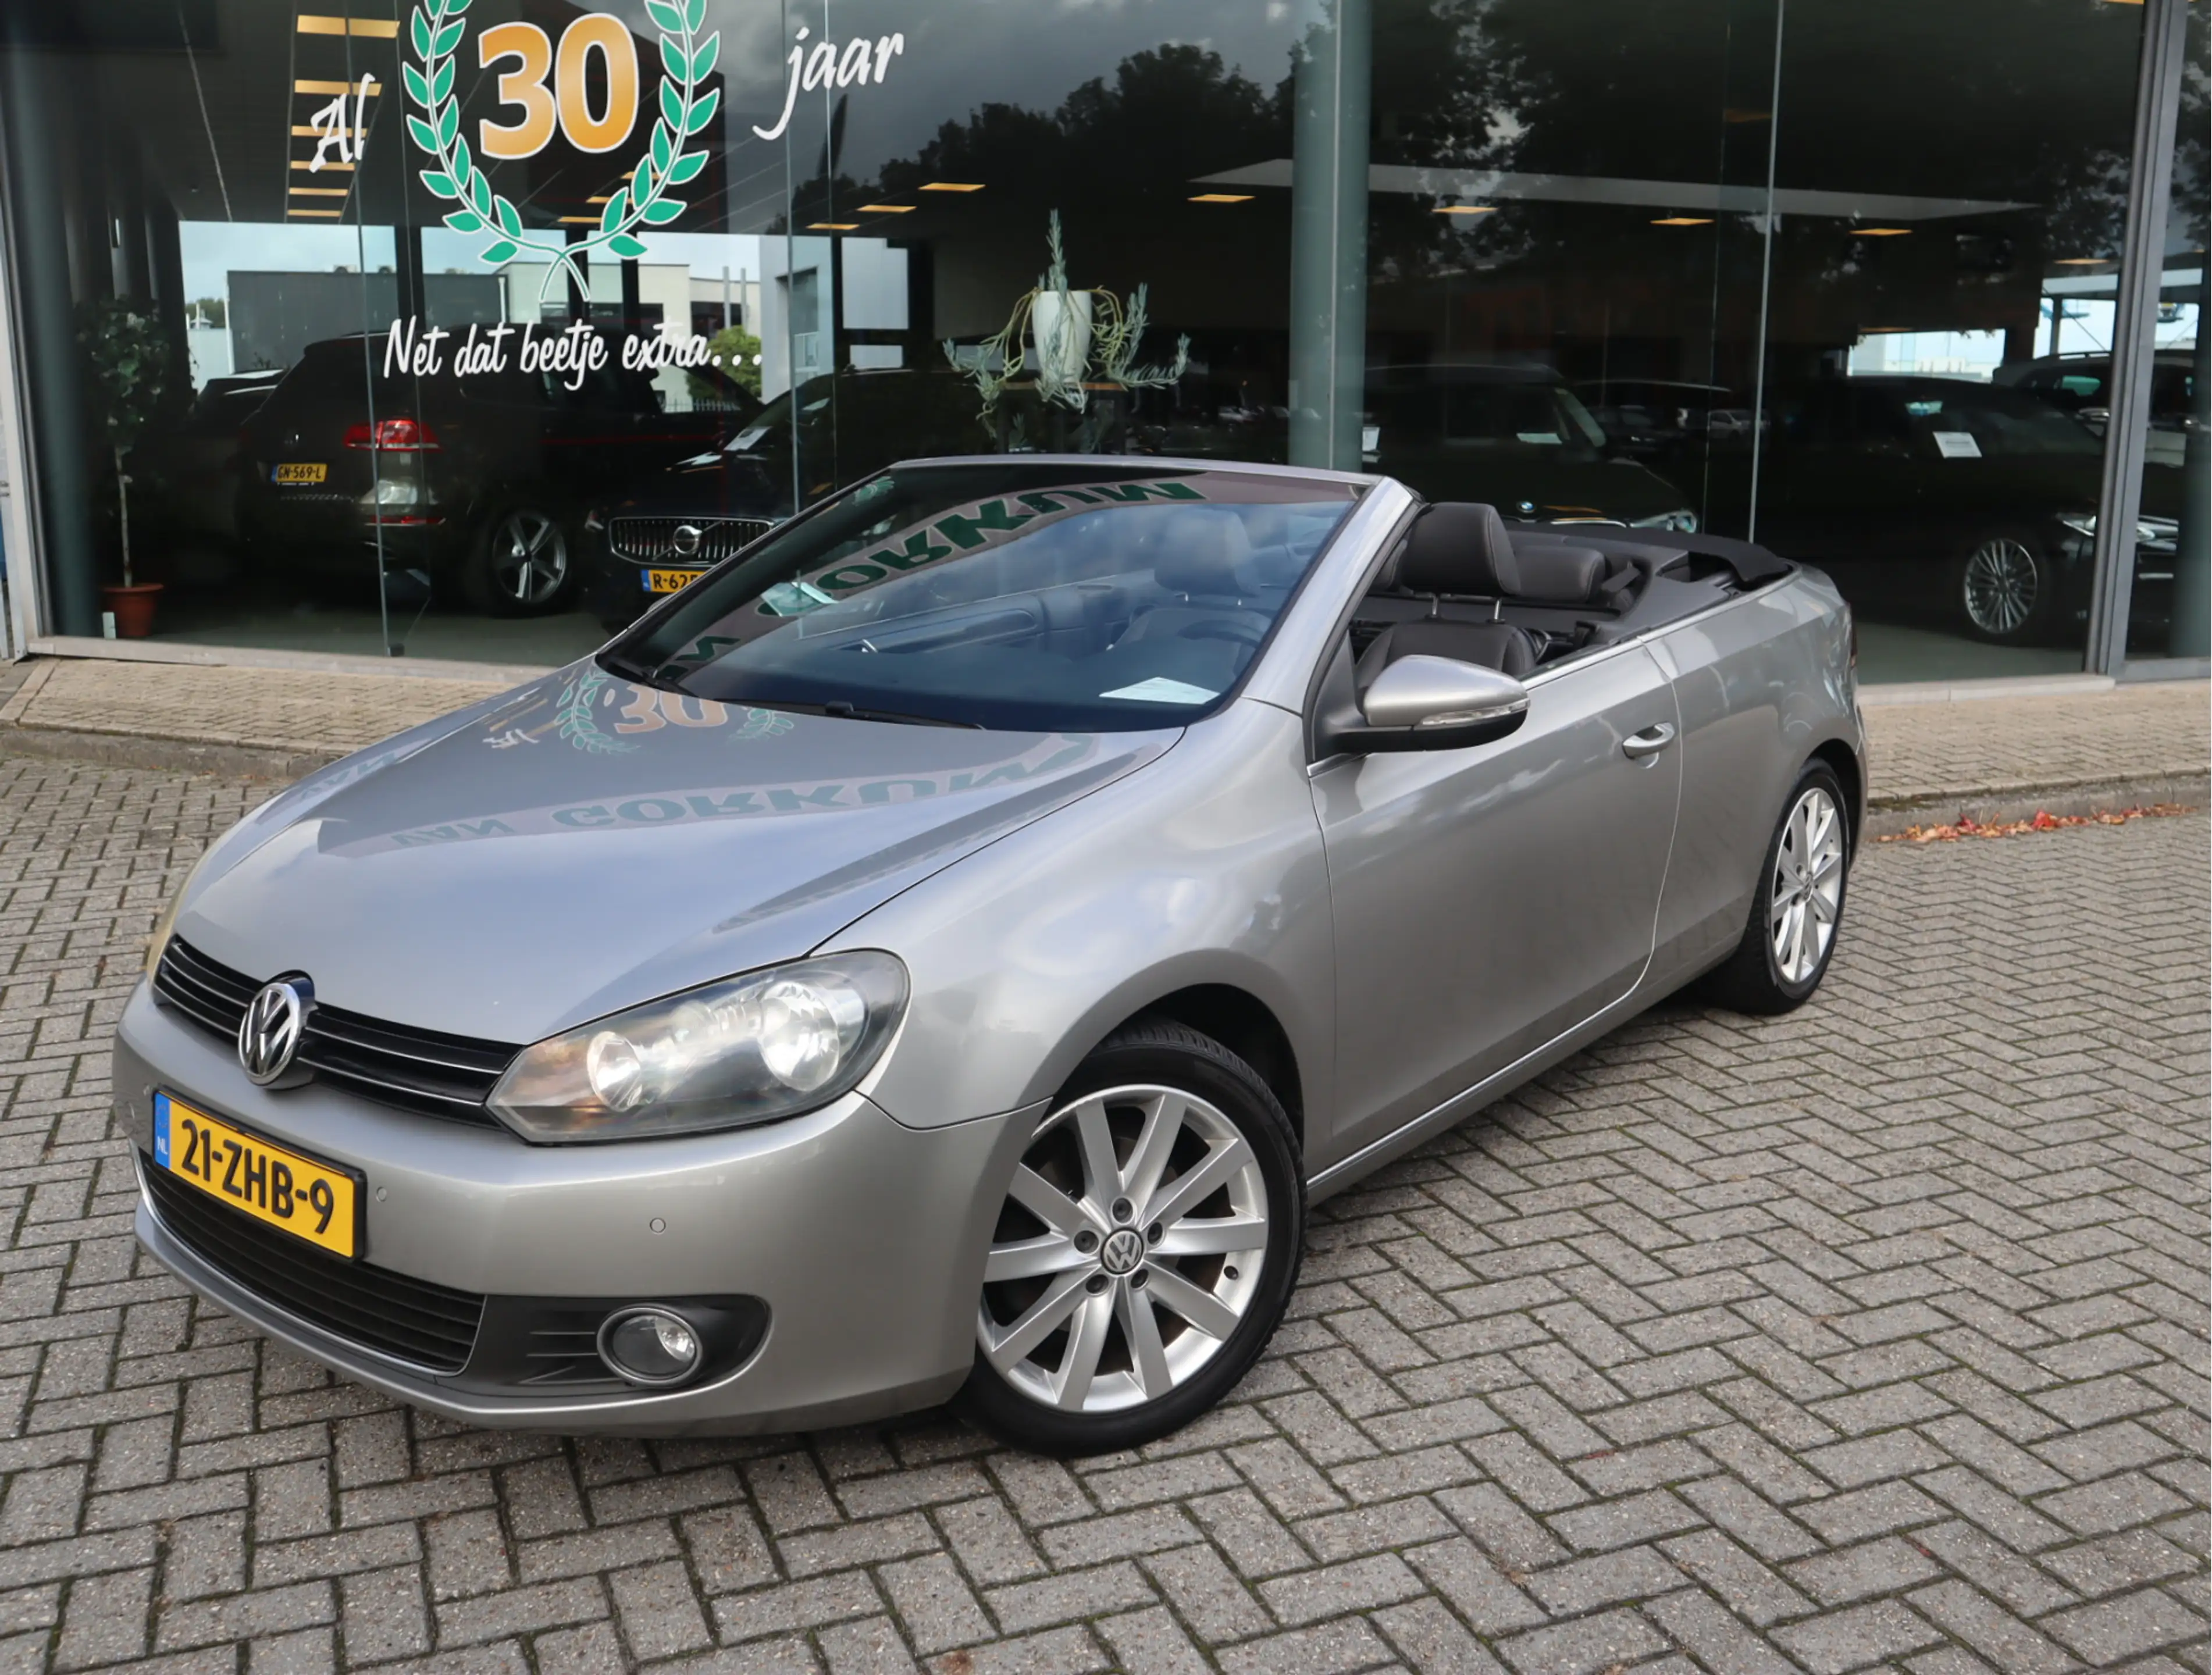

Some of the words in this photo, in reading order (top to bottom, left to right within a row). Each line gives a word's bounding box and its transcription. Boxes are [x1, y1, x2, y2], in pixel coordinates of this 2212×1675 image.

[309, 73, 375, 173] Al
[478, 13, 640, 161] 30
[752, 27, 904, 141] jaar
[383, 315, 449, 378] Net
[454, 324, 515, 377] dat
[519, 318, 608, 391] beetje
[622, 323, 763, 369] extra...
[181, 1118, 334, 1235] 21-ZHB-9
